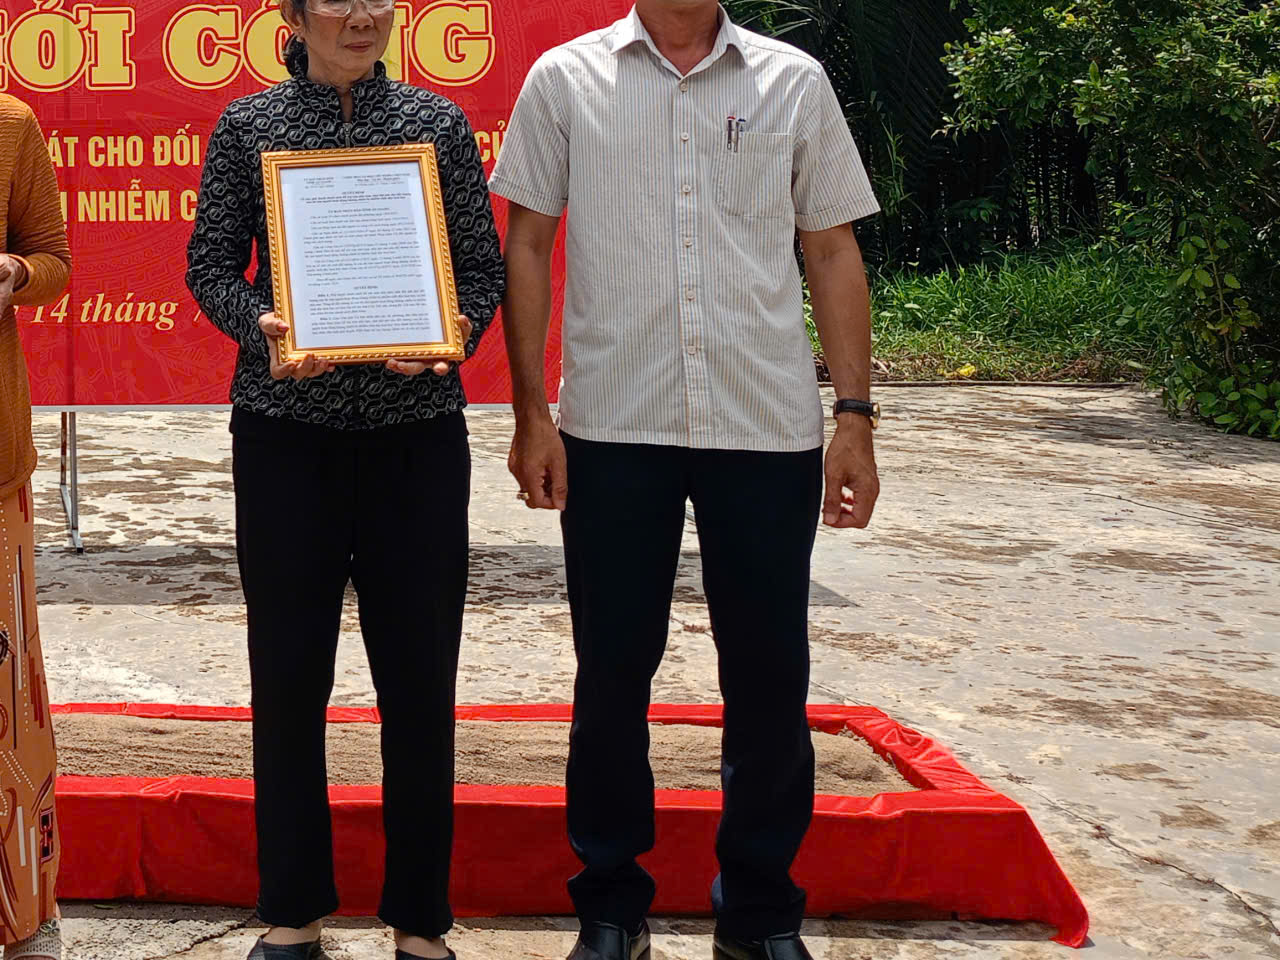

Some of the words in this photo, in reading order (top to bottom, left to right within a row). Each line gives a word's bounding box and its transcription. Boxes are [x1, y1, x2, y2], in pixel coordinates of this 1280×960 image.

[88, 135, 144, 167] CHO
[153, 123, 200, 166] ĐỐI
[78, 178, 170, 222] NHIỄM
[31, 293, 70, 324] 14
[80, 292, 179, 331] tháng
